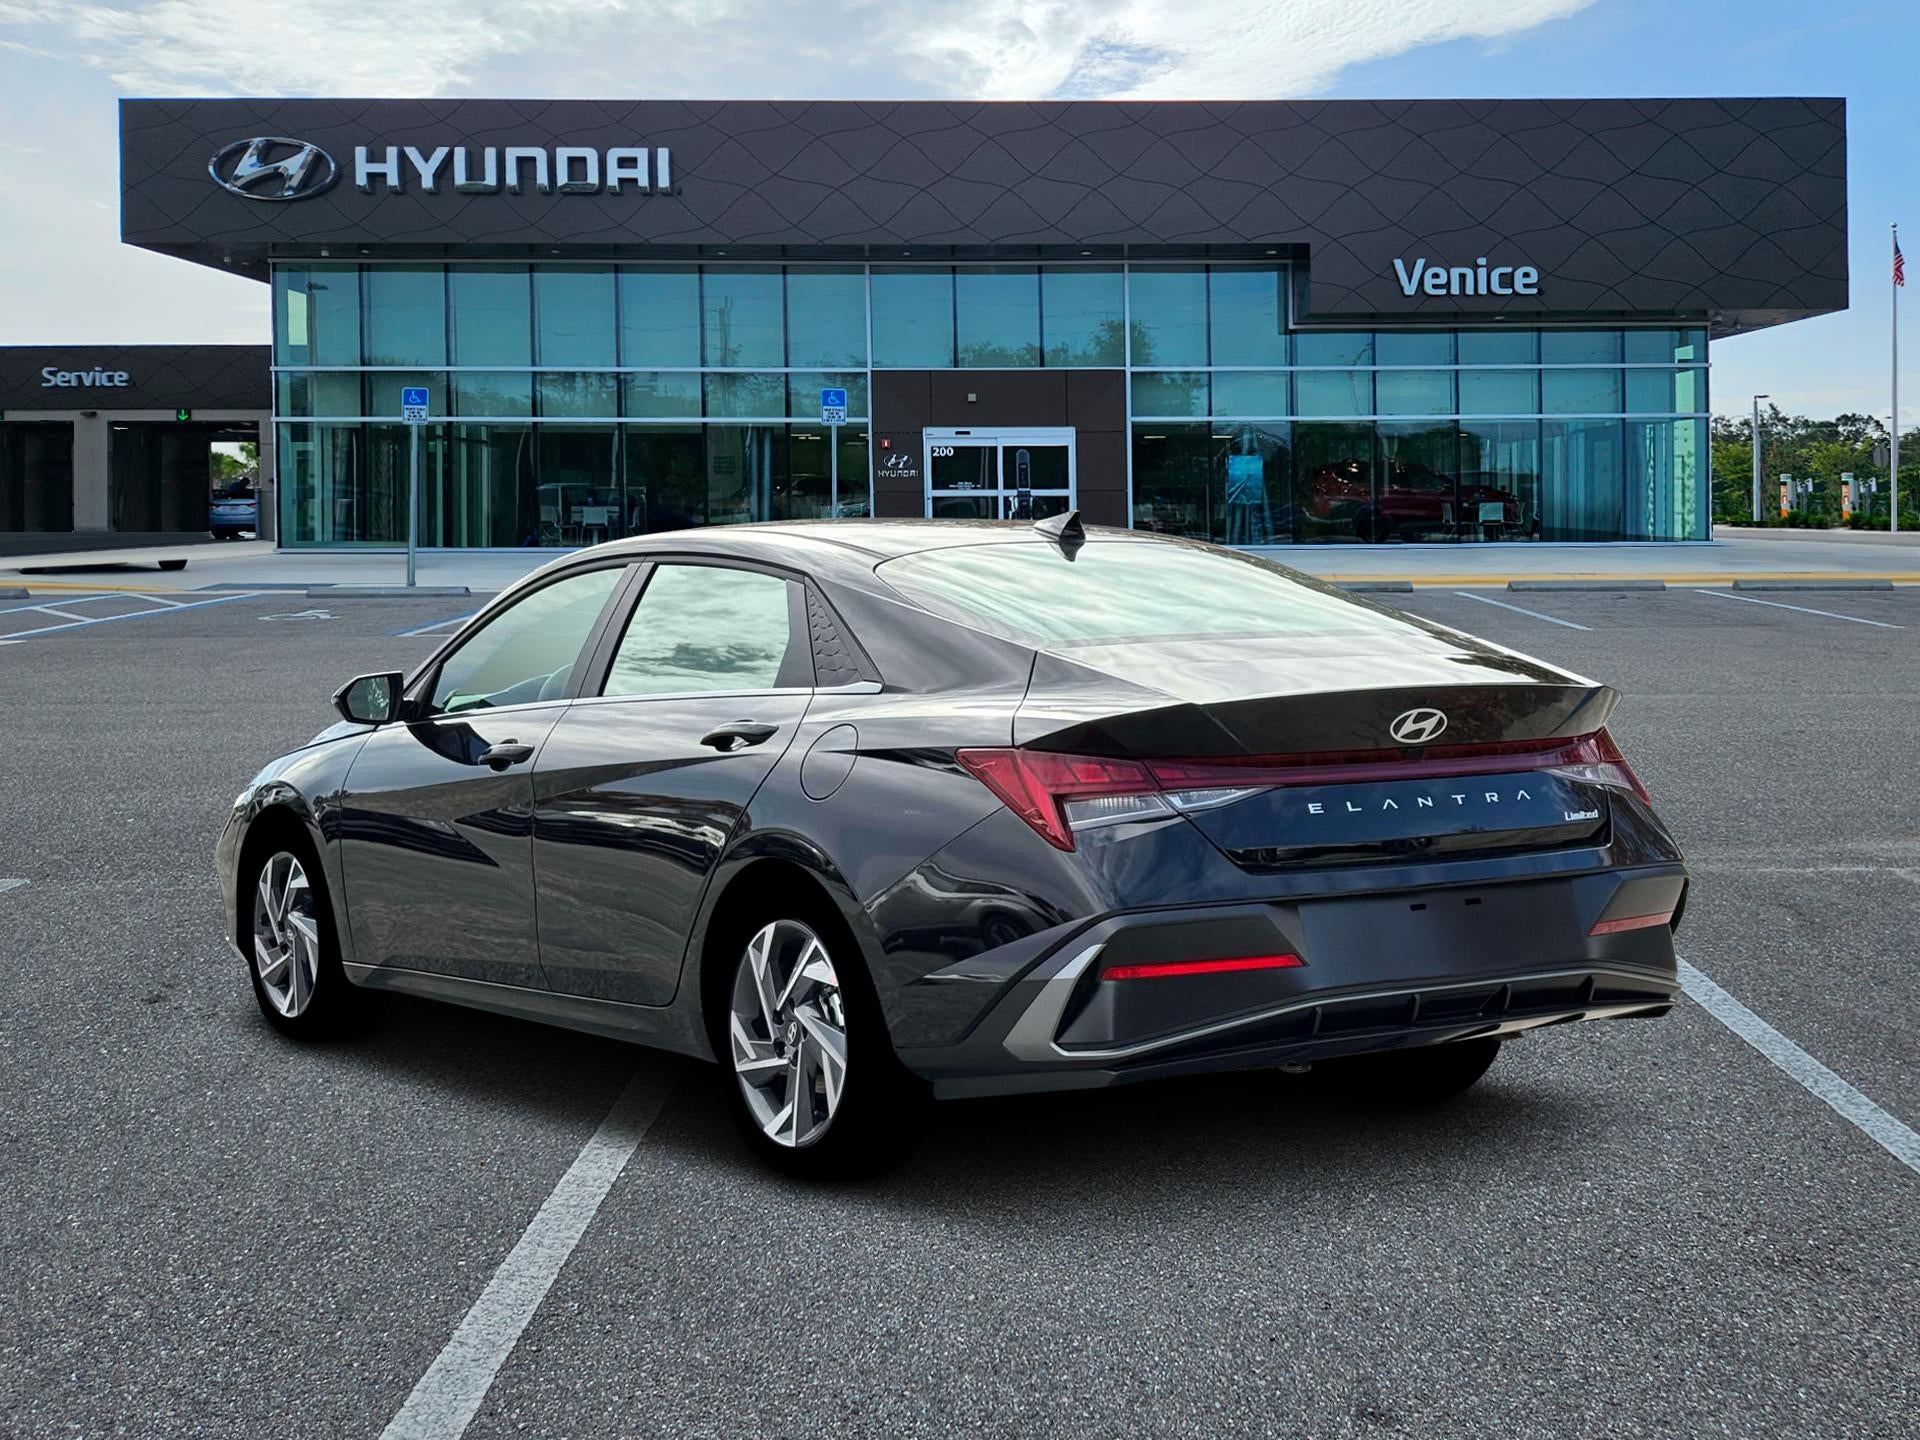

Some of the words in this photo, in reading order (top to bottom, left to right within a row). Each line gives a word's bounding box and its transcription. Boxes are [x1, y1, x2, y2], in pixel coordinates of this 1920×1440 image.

[355, 146, 671, 194] HYUNDAI
[1393, 257, 1539, 296] Venice
[41, 366, 129, 387] Service
[932, 446, 954, 457] 200
[1308, 790, 1531, 814] ELANTRA
[1564, 809, 1599, 821] Limited
